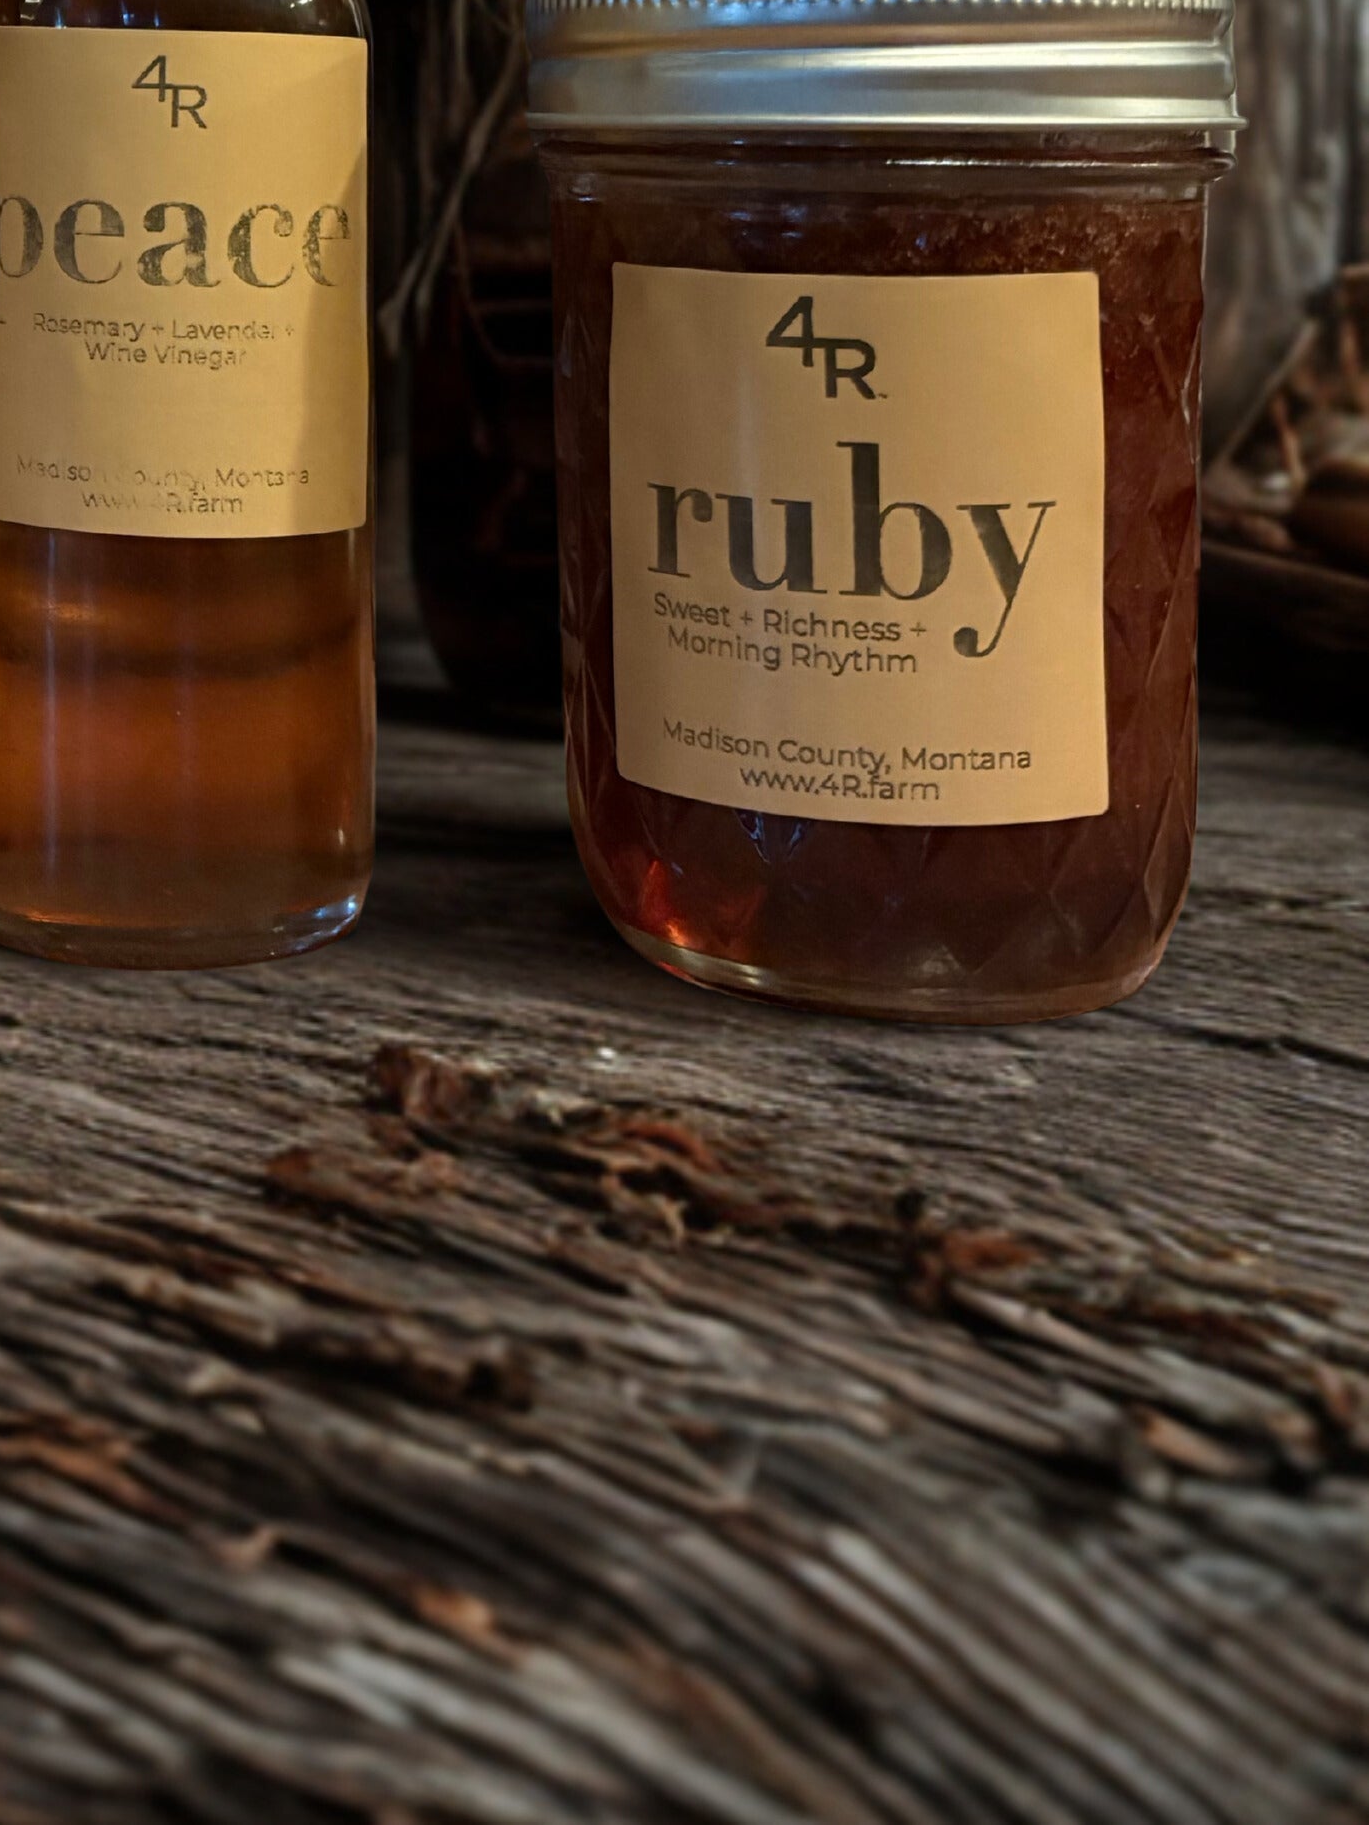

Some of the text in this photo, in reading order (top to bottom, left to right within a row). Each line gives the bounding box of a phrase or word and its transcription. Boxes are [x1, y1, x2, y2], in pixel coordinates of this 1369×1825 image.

[132, 55, 207, 128] 4R
[32, 312, 145, 342] Rosemary
[152, 324, 164, 335] +
[85, 341, 248, 371] Wine Vinegar
[16, 453, 107, 483] Madso
[647, 441, 1057, 658] ruby
[654, 592, 926, 642] Sweet + Richness +
[667, 625, 918, 676] Morning Rhythm
[663, 717, 1032, 775] Madison County, Montana
[740, 767, 940, 801] www.4R.farm
